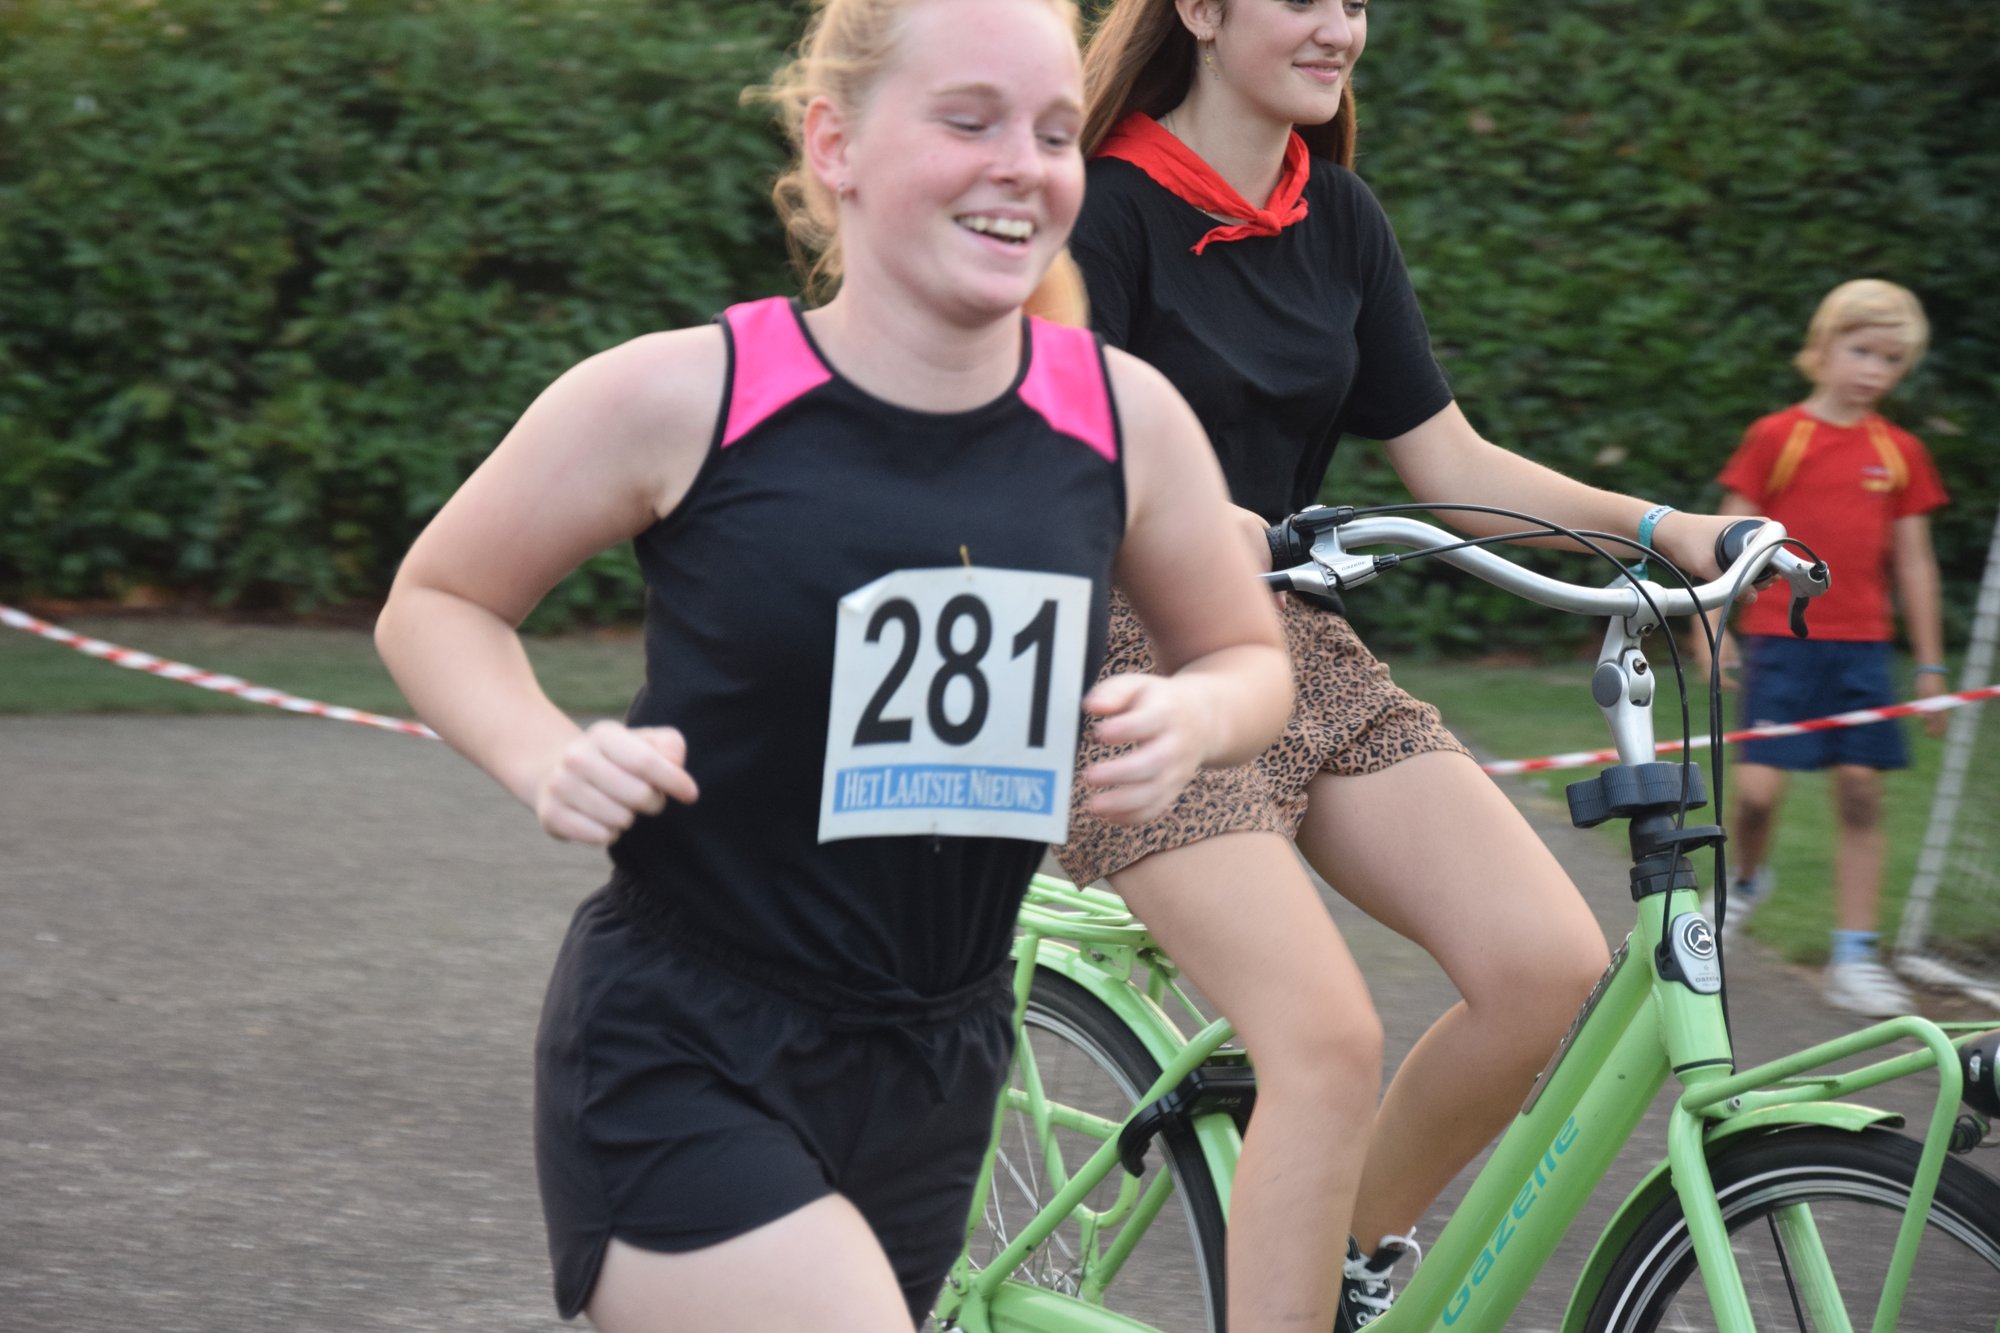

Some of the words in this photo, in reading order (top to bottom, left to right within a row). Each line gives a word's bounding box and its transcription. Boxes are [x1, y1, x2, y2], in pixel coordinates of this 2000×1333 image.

[851, 593, 1058, 749] 281
[881, 768, 966, 806] LAATSTE
[967, 769, 1046, 810] NIEUWS
[1442, 1115, 1580, 1327] Gazelle
